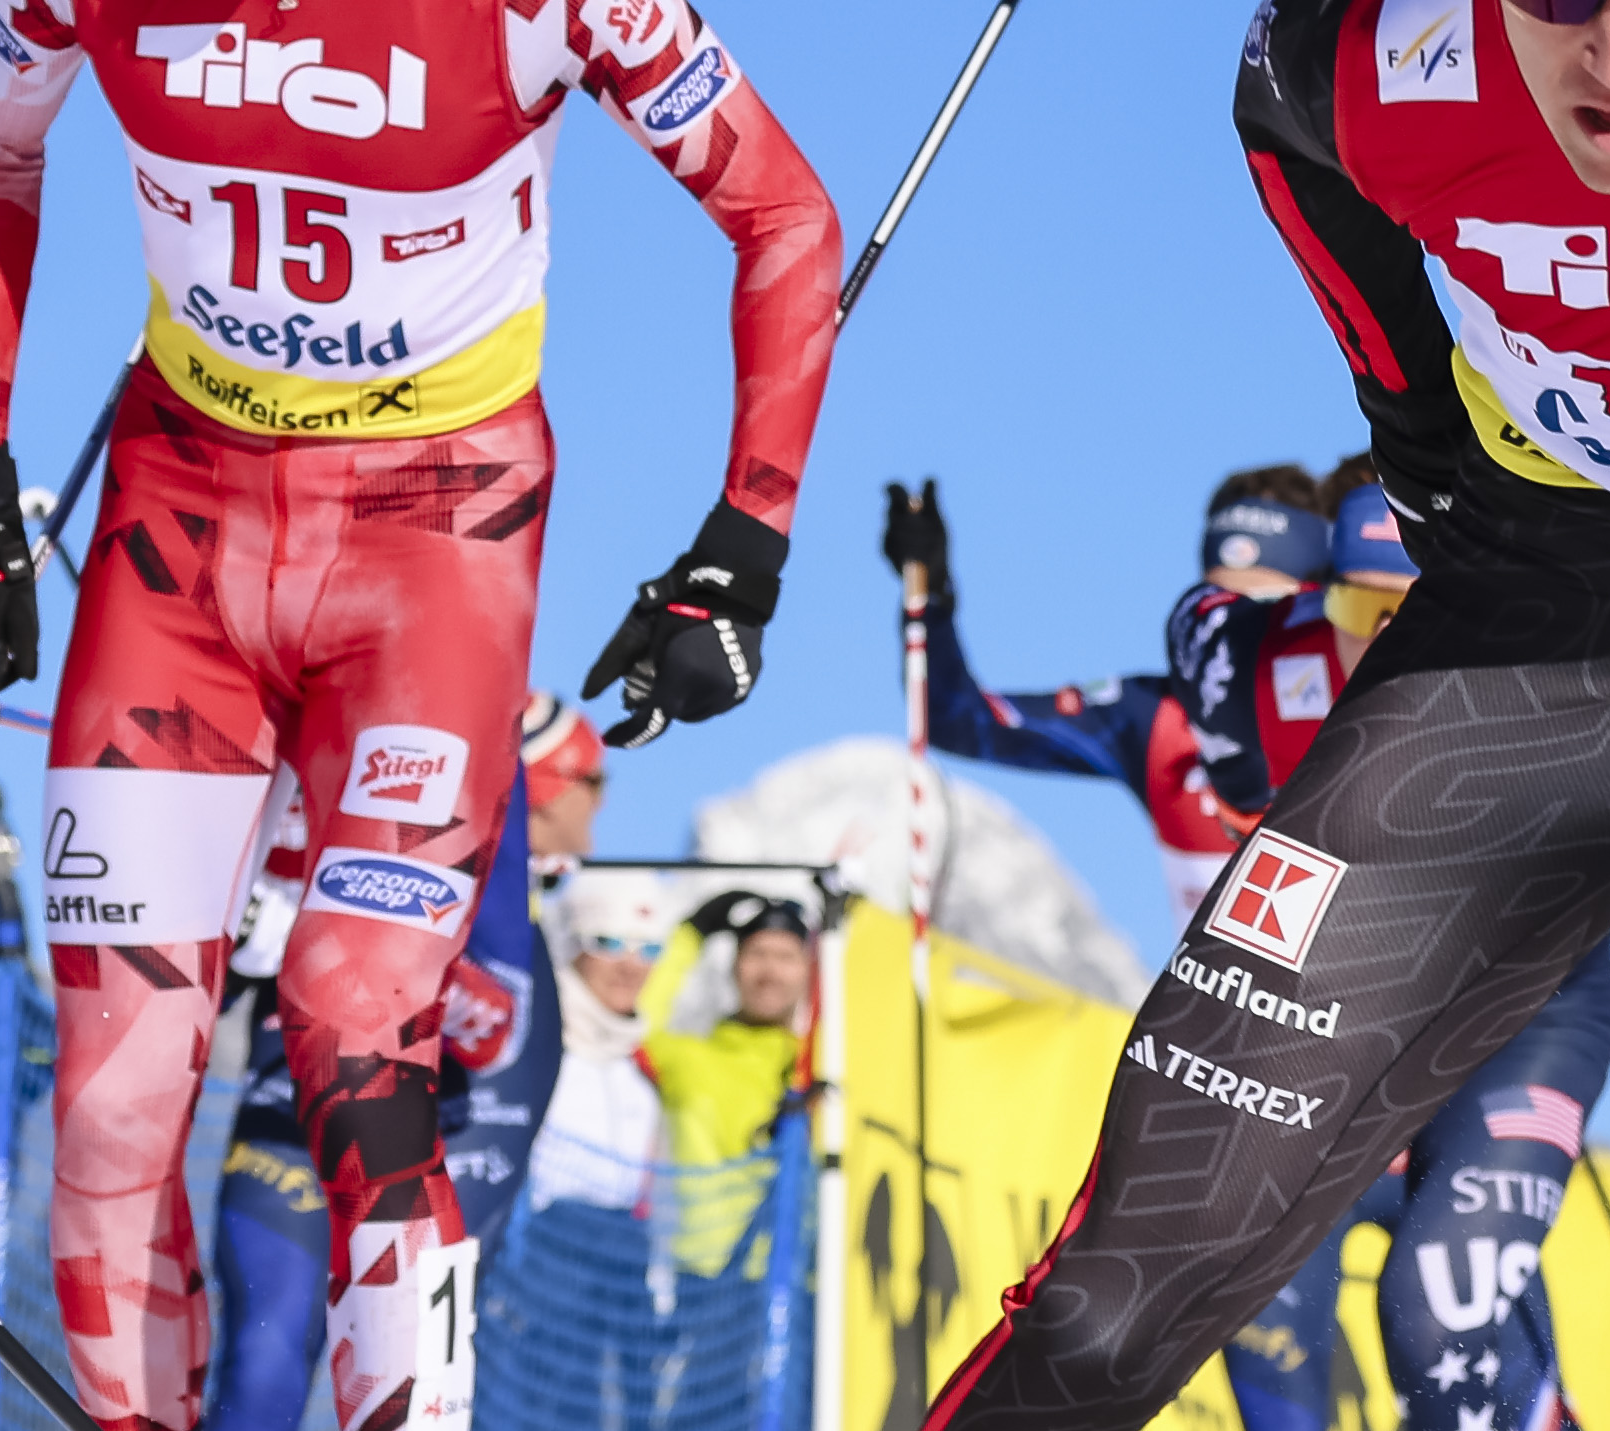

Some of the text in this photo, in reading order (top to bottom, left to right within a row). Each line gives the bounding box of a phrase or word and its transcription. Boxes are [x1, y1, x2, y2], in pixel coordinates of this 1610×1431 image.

[136, 22, 427, 140] Tirol
[648, 49, 720, 127] personal
[1387, 47, 1462, 70] FIS
[673, 75, 713, 122] shop
[210, 180, 352, 304] 15
[182, 283, 409, 368] Seefeld
[188, 354, 350, 433] Raiffeisen
[358, 748, 448, 786] Stiegl
[321, 863, 450, 901] personal
[340, 879, 411, 911] shop
[1162, 1042, 1326, 1132] TERREX
